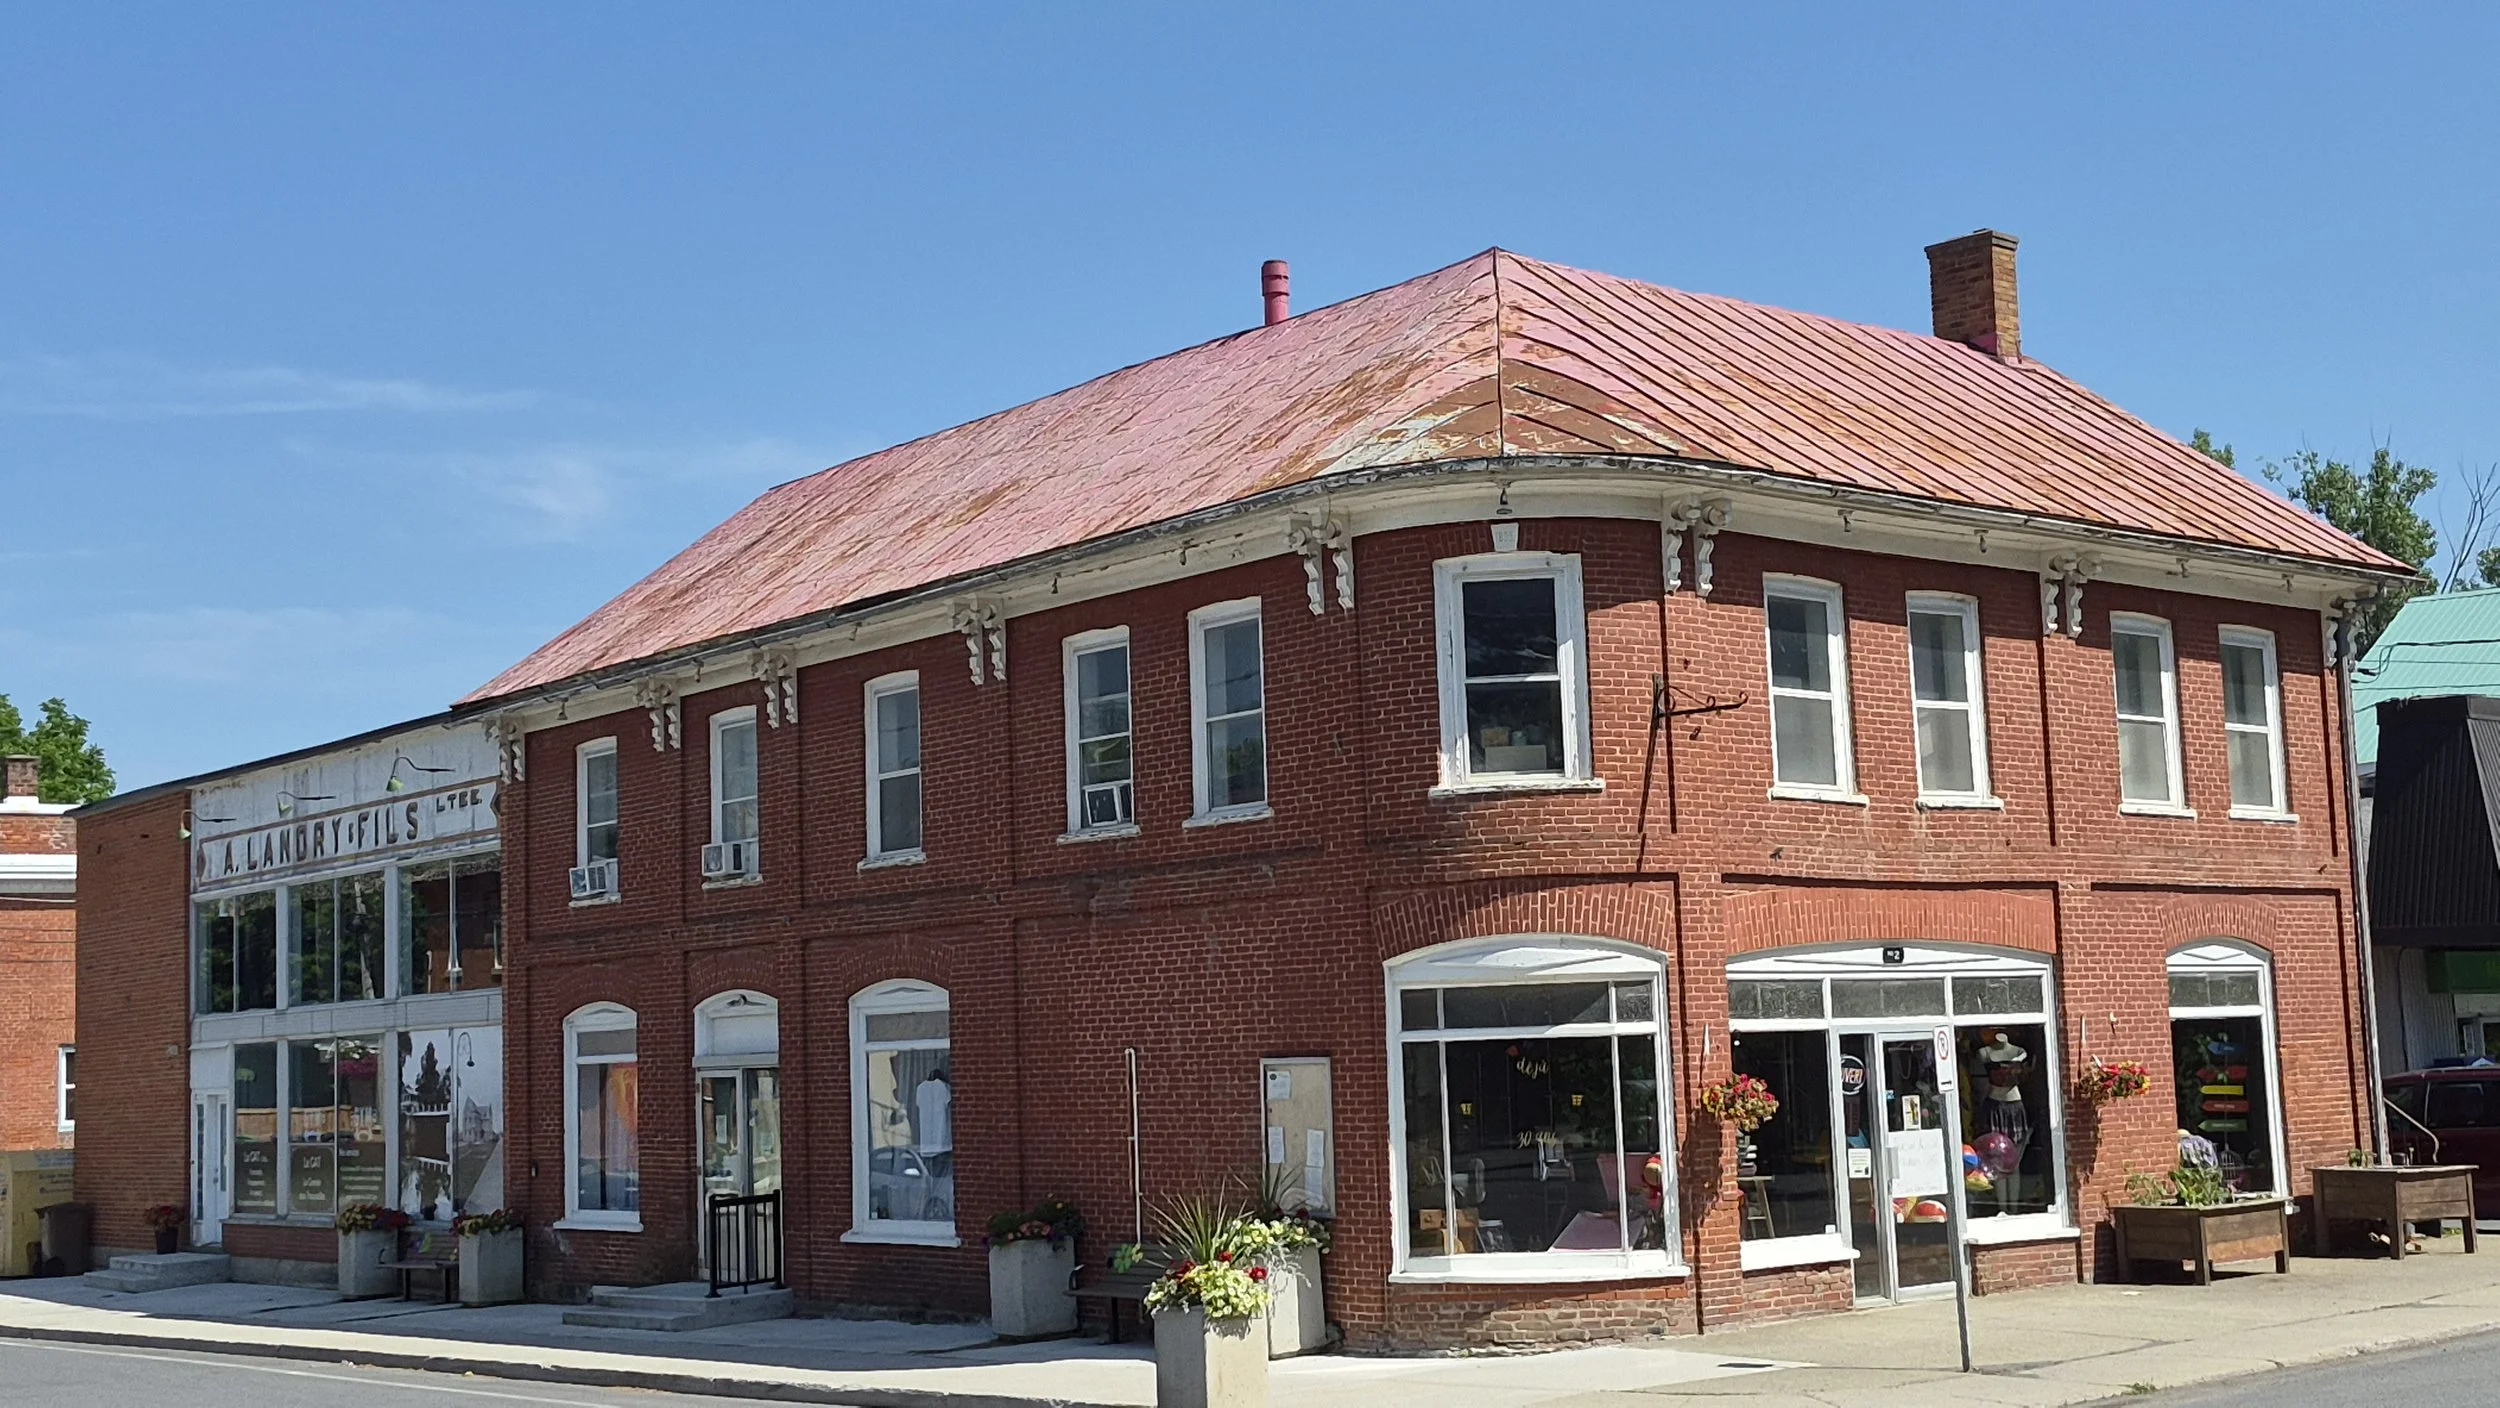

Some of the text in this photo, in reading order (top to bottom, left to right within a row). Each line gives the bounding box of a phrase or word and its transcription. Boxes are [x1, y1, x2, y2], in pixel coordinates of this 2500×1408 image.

[224, 840, 239, 876] A.
[247, 817, 342, 870] LANDRY
[358, 802, 419, 850] FILS
[1517, 1130, 1532, 1149] 30
